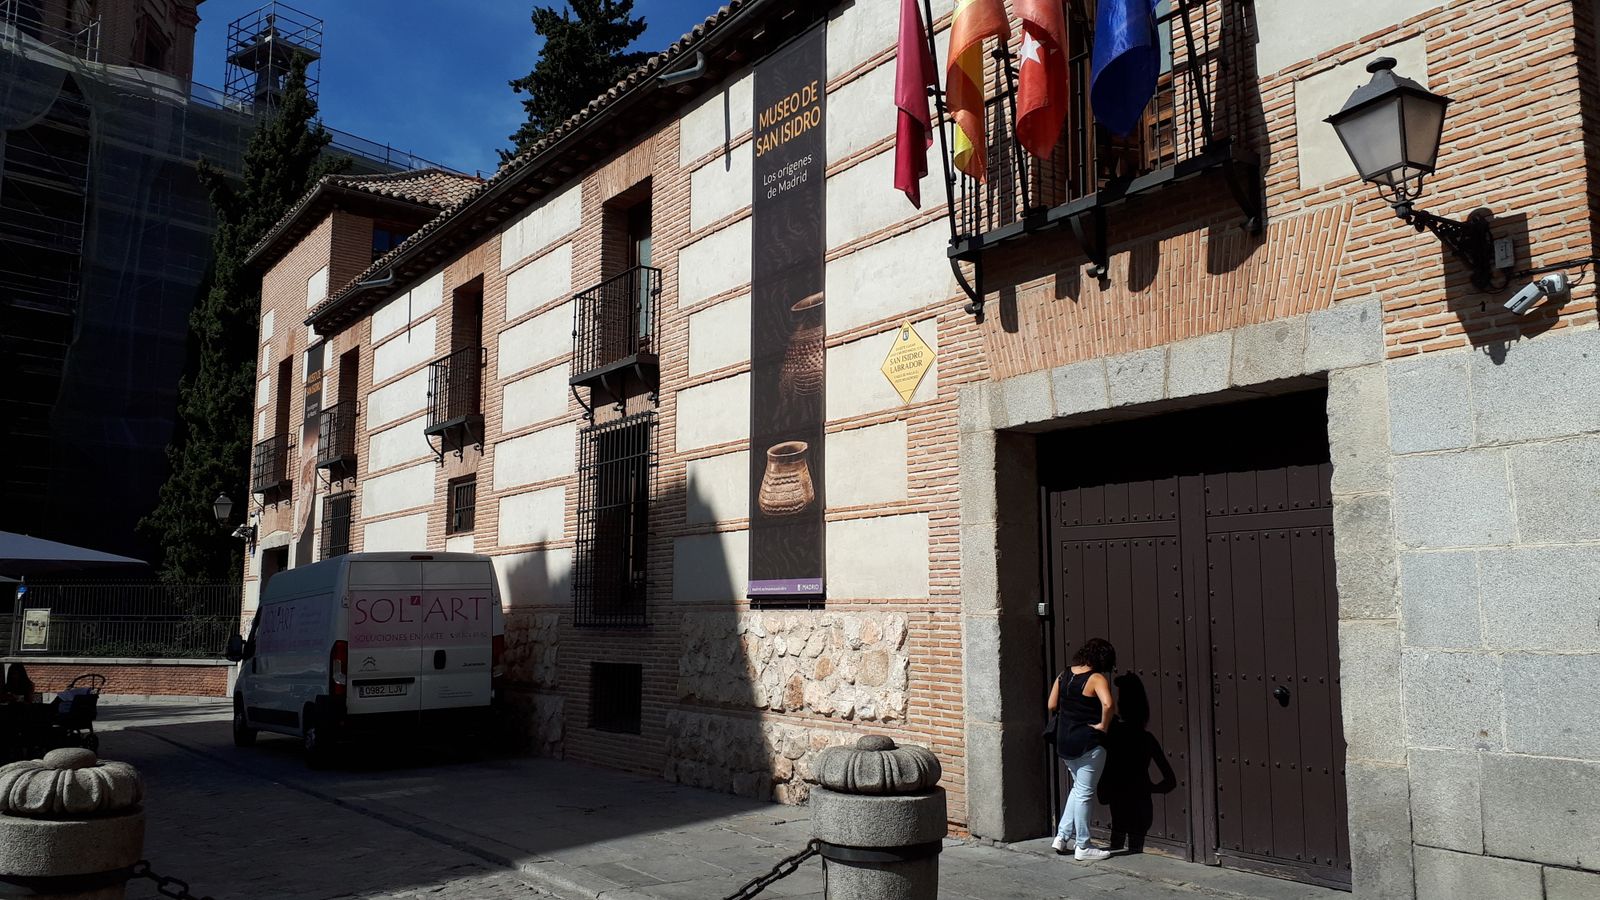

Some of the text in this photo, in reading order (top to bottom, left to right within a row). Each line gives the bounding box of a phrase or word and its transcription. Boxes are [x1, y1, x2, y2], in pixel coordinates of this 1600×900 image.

[759, 80, 818, 132] MUSEO DE
[756, 105, 821, 158] SAN ISIDRO
[763, 153, 812, 186] Los orígenes
[767, 169, 808, 199] de Madrid
[890, 356, 901, 366] SAN
[902, 351, 923, 362] ISIDRO
[890, 361, 922, 374] LABRADOR
[355, 632, 444, 642] SOLUCIONES EN ARTE
[365, 686, 385, 695] 0982
